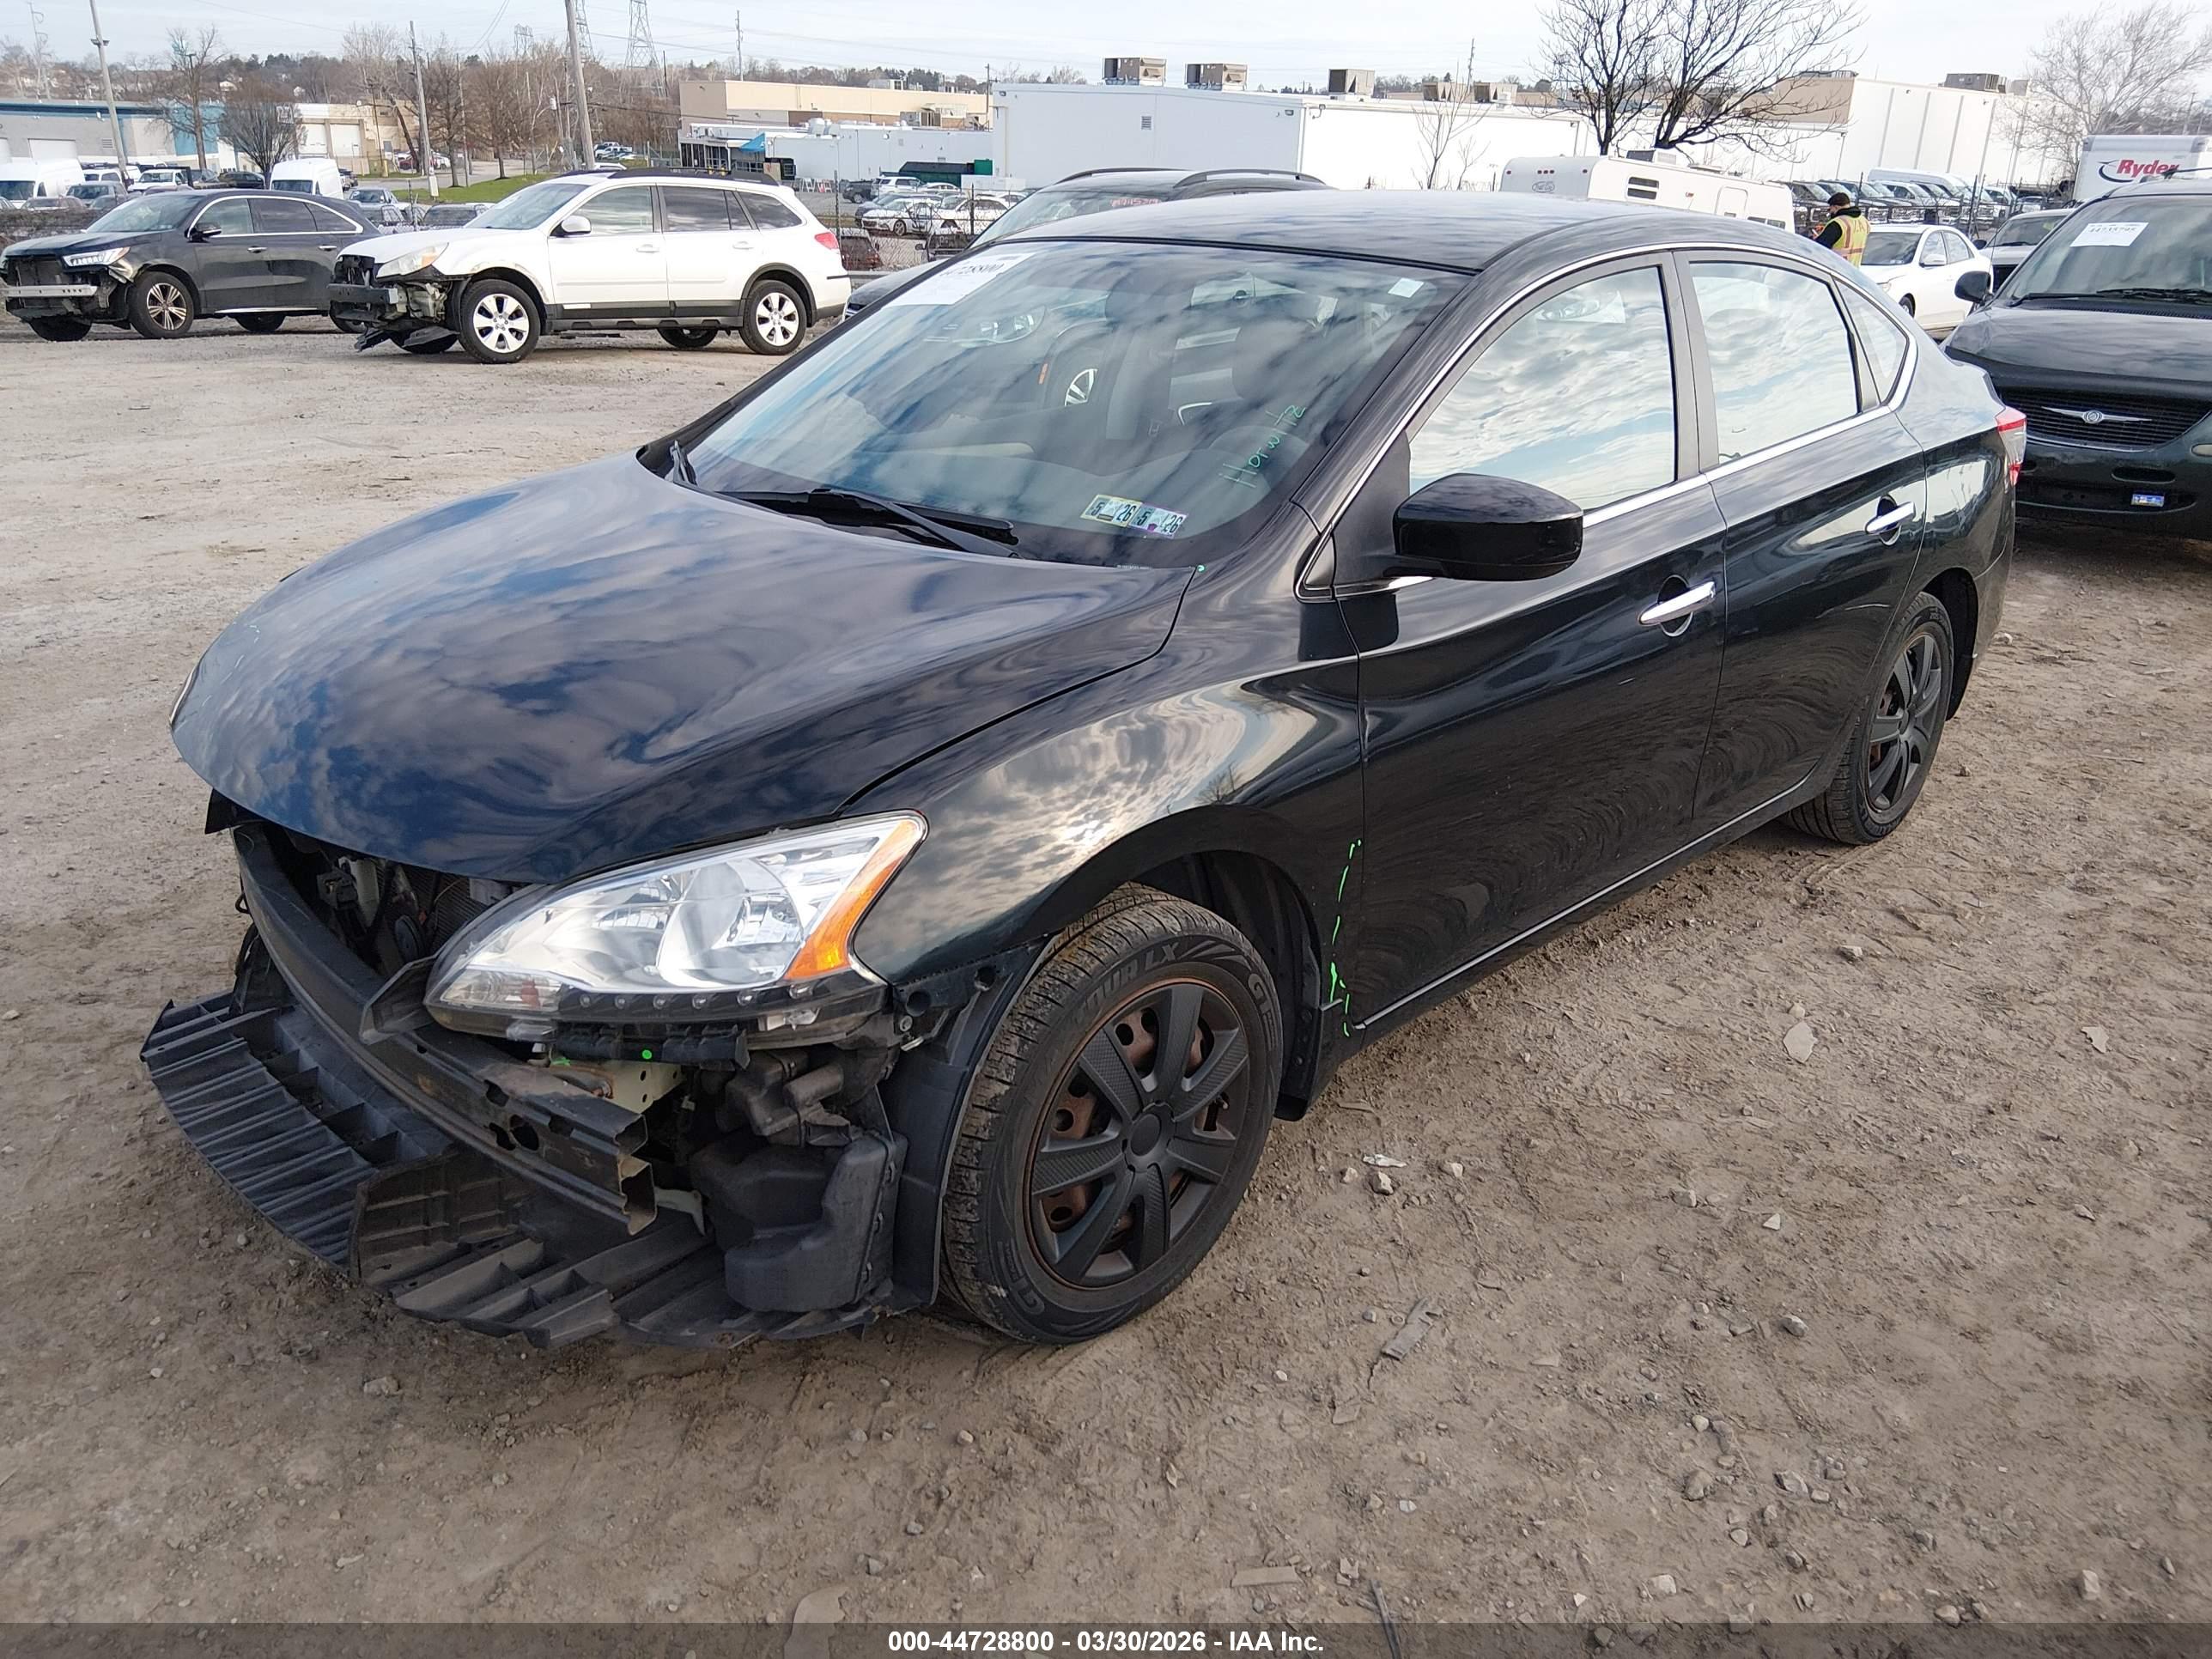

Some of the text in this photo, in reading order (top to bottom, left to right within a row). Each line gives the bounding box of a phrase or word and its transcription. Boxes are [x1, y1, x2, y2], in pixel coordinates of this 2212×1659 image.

[2117, 159, 2179, 178] Ryder
[1116, 504, 1136, 522] 26
[1137, 511, 1183, 533] 5 26
[1145, 942, 1180, 971] LX
